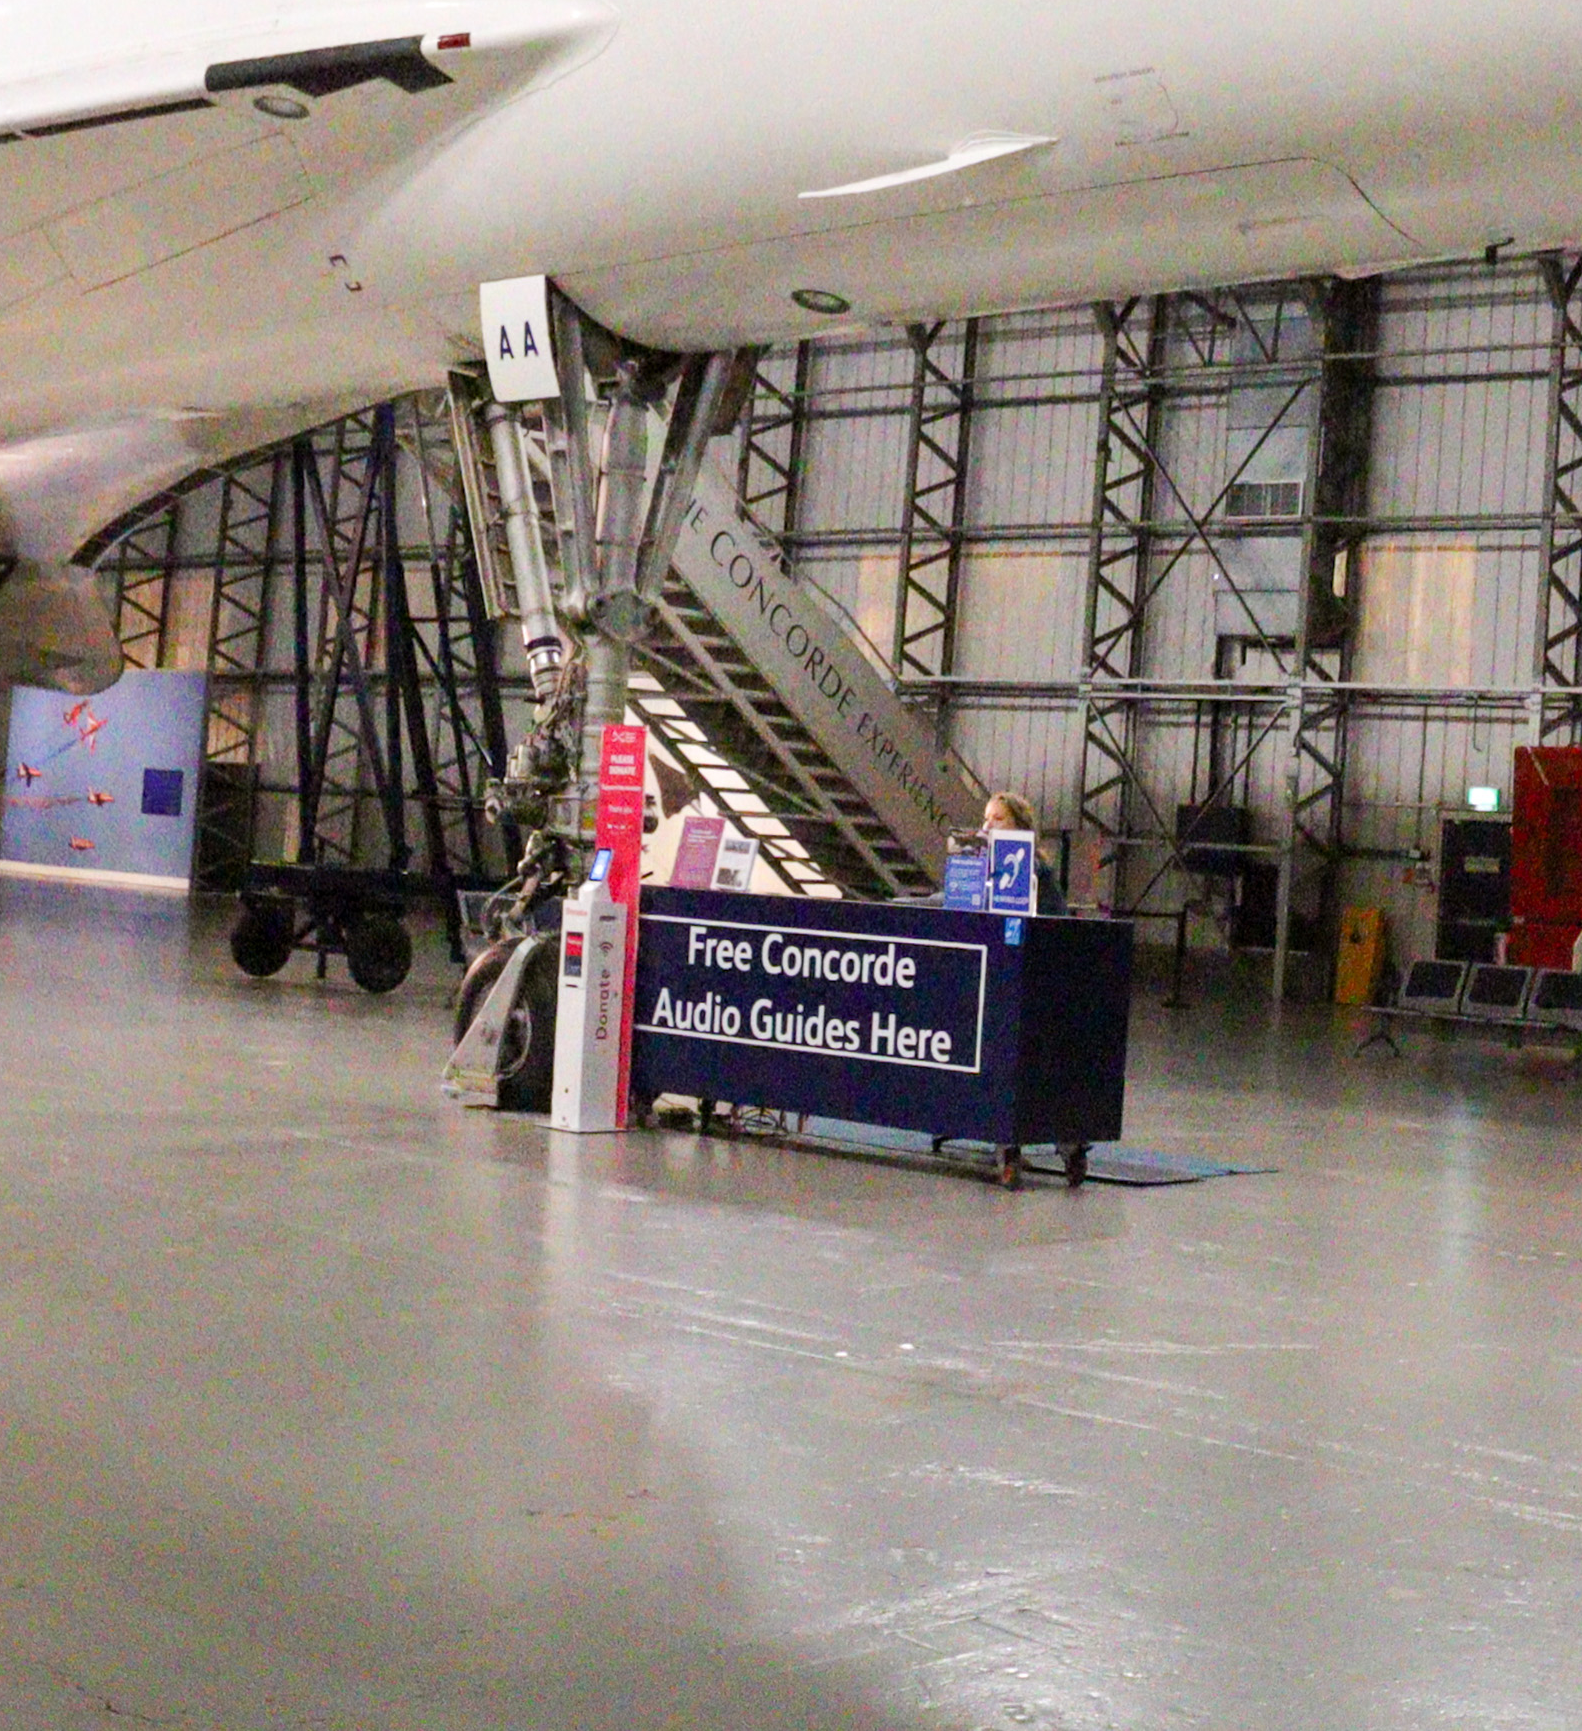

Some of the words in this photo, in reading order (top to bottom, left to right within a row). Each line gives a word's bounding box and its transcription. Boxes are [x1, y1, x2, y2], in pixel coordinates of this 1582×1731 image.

[500, 324, 515, 360] A
[524, 320, 539, 358] A
[709, 530, 857, 714] CONCORDE
[855, 711, 951, 836] EXPERIENC
[608, 765, 637, 776] DONATE
[609, 753, 635, 766] PLEASE
[687, 925, 753, 972] Free
[761, 933, 917, 989] Concorde
[595, 968, 611, 1041] Donate
[651, 987, 741, 1037] Audio
[750, 998, 861, 1052] Guides
[870, 1011, 953, 1063] Here
